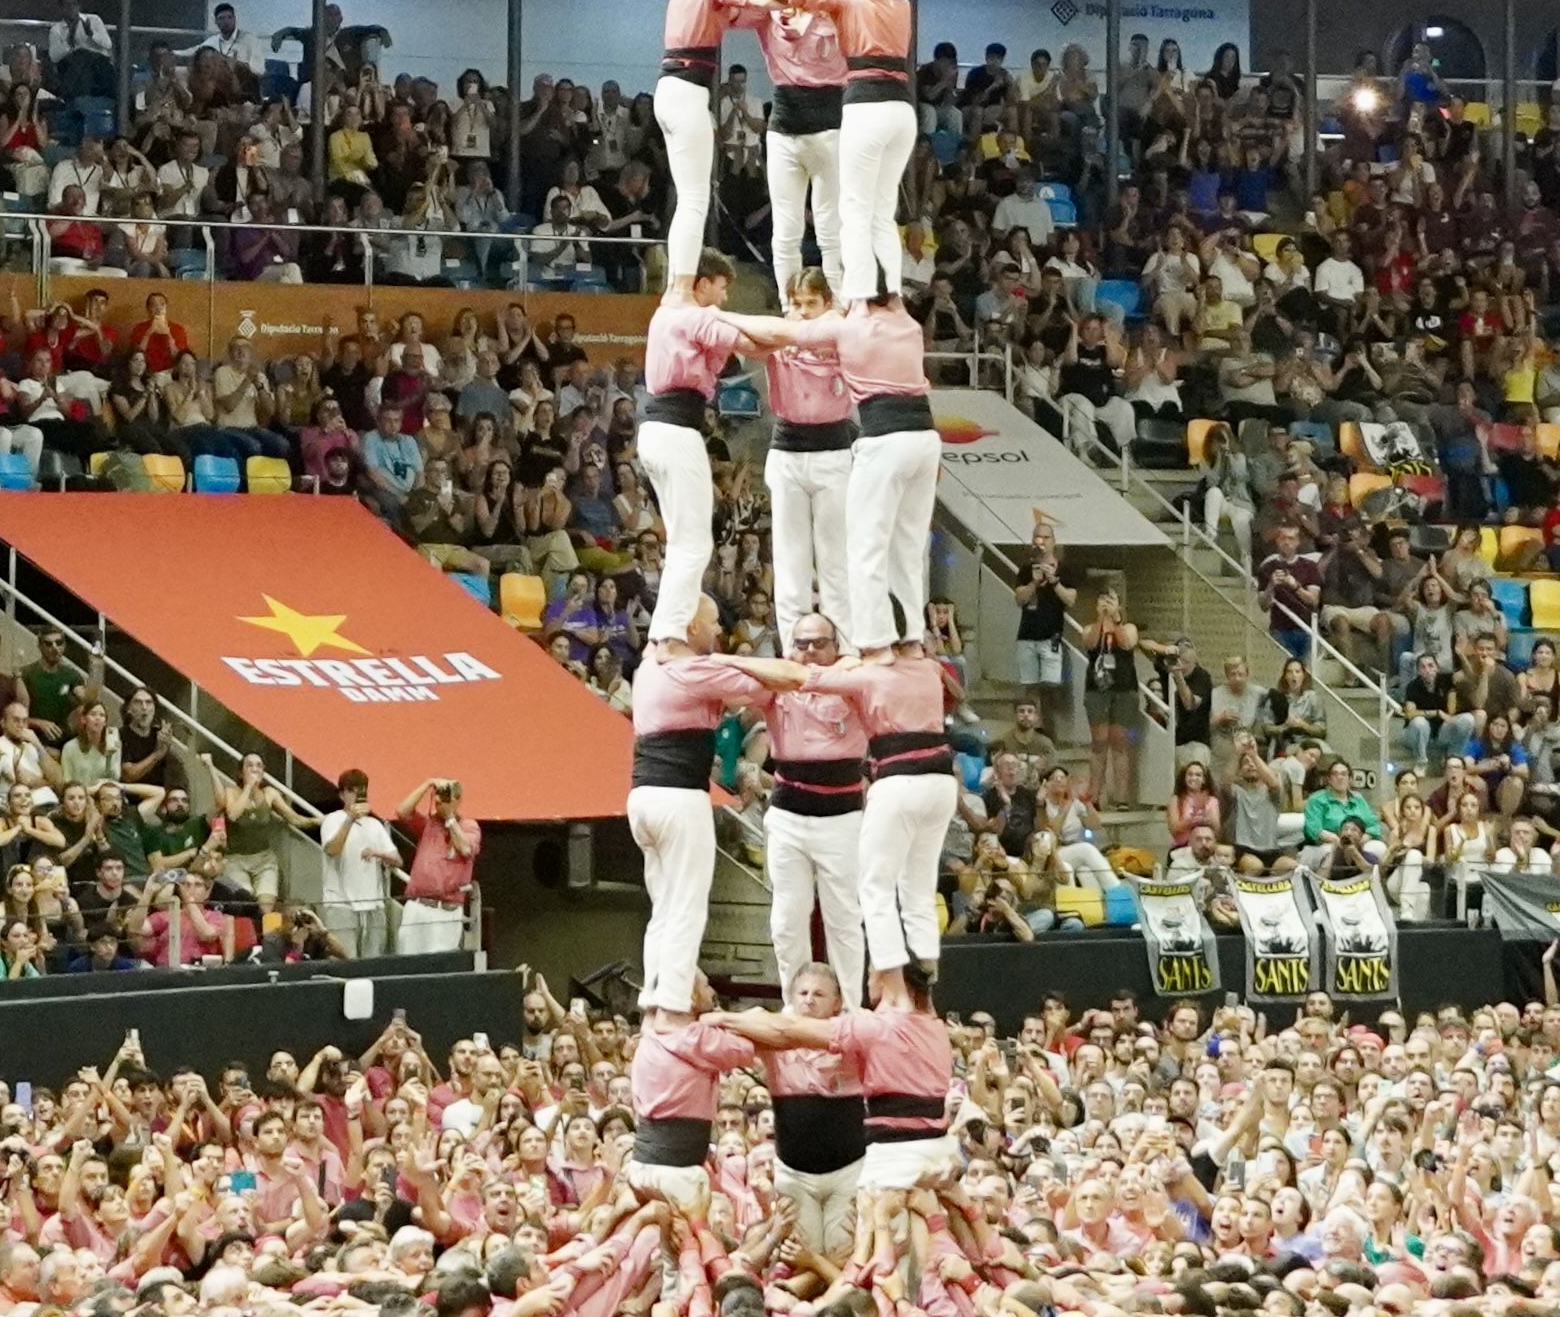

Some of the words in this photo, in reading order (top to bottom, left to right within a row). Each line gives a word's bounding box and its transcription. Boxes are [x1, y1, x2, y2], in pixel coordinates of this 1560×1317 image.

[941, 449, 1030, 466] epsol
[220, 651, 503, 687] ESTRELLA
[338, 684, 441, 703] DAMM
[1158, 956, 1212, 992] SANTS
[1255, 957, 1308, 994] SANTS
[1336, 956, 1390, 994] SANTS
